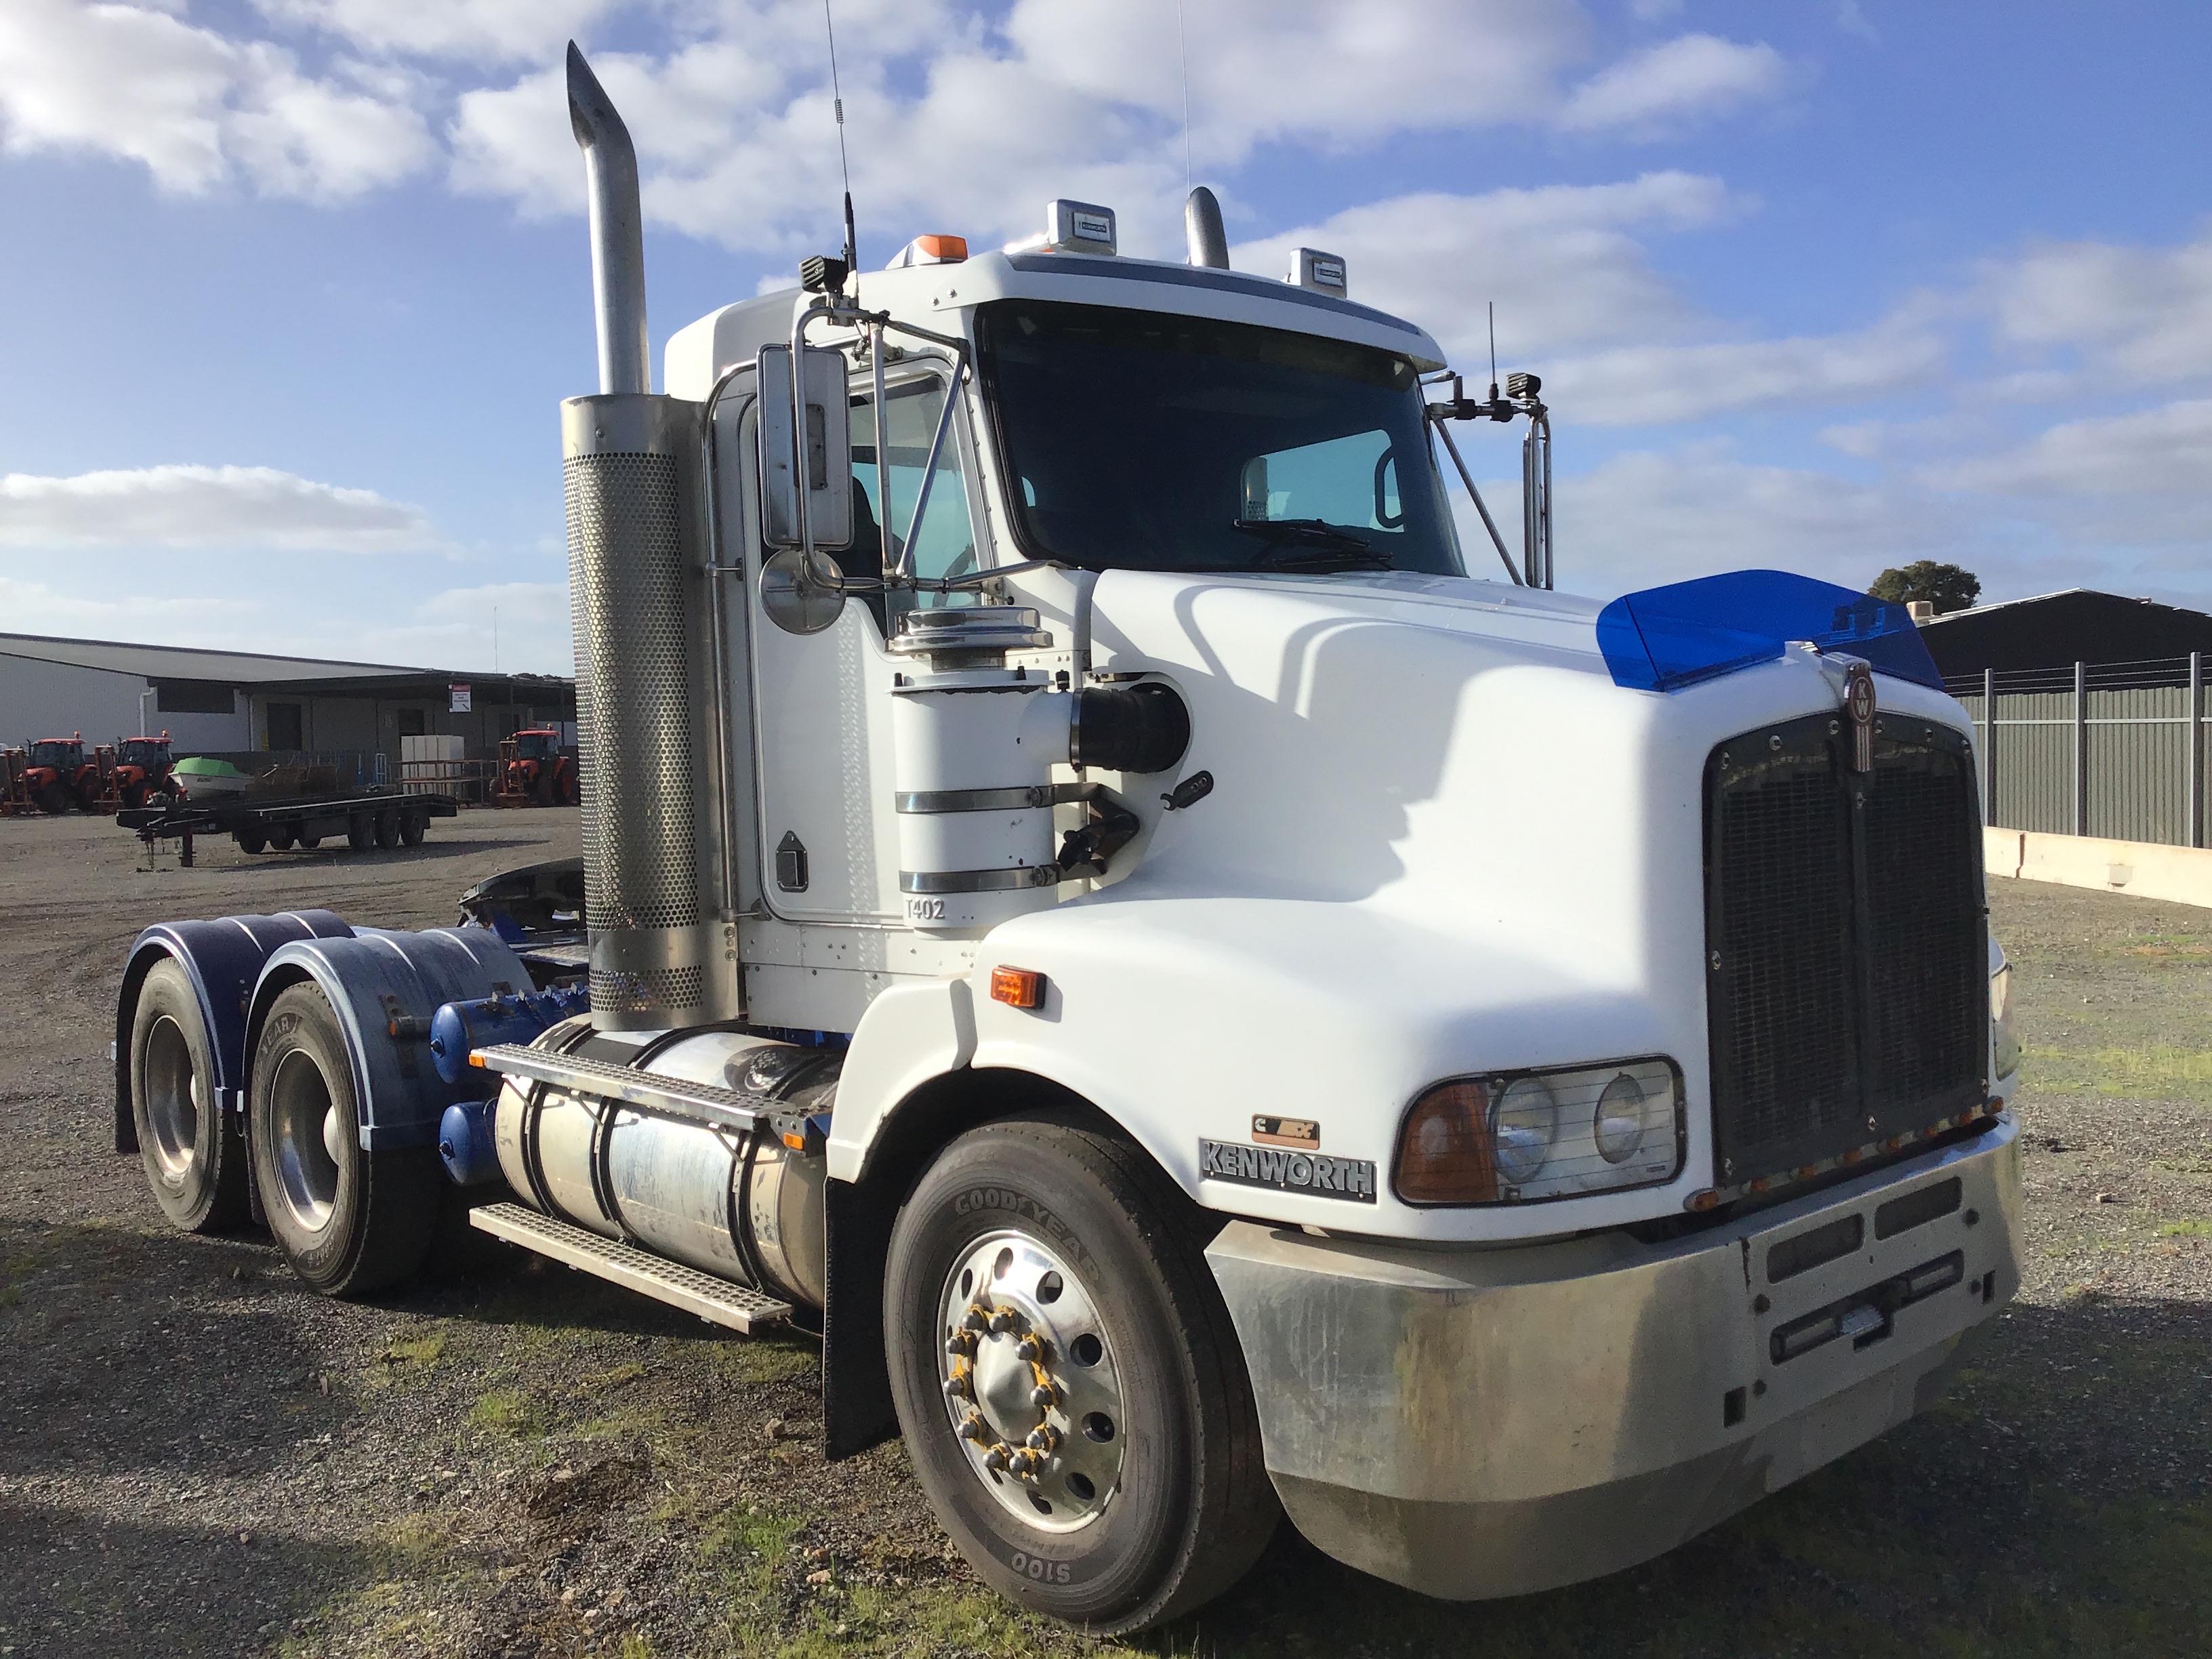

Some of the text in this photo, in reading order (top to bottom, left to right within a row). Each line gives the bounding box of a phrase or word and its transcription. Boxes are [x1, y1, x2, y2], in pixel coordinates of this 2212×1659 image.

[905, 897, 946, 920] T402
[1203, 1142, 1372, 1194] KENWORTH
[954, 1188, 1099, 1281] GOODYEAR
[1010, 1552, 1071, 1583] S100
